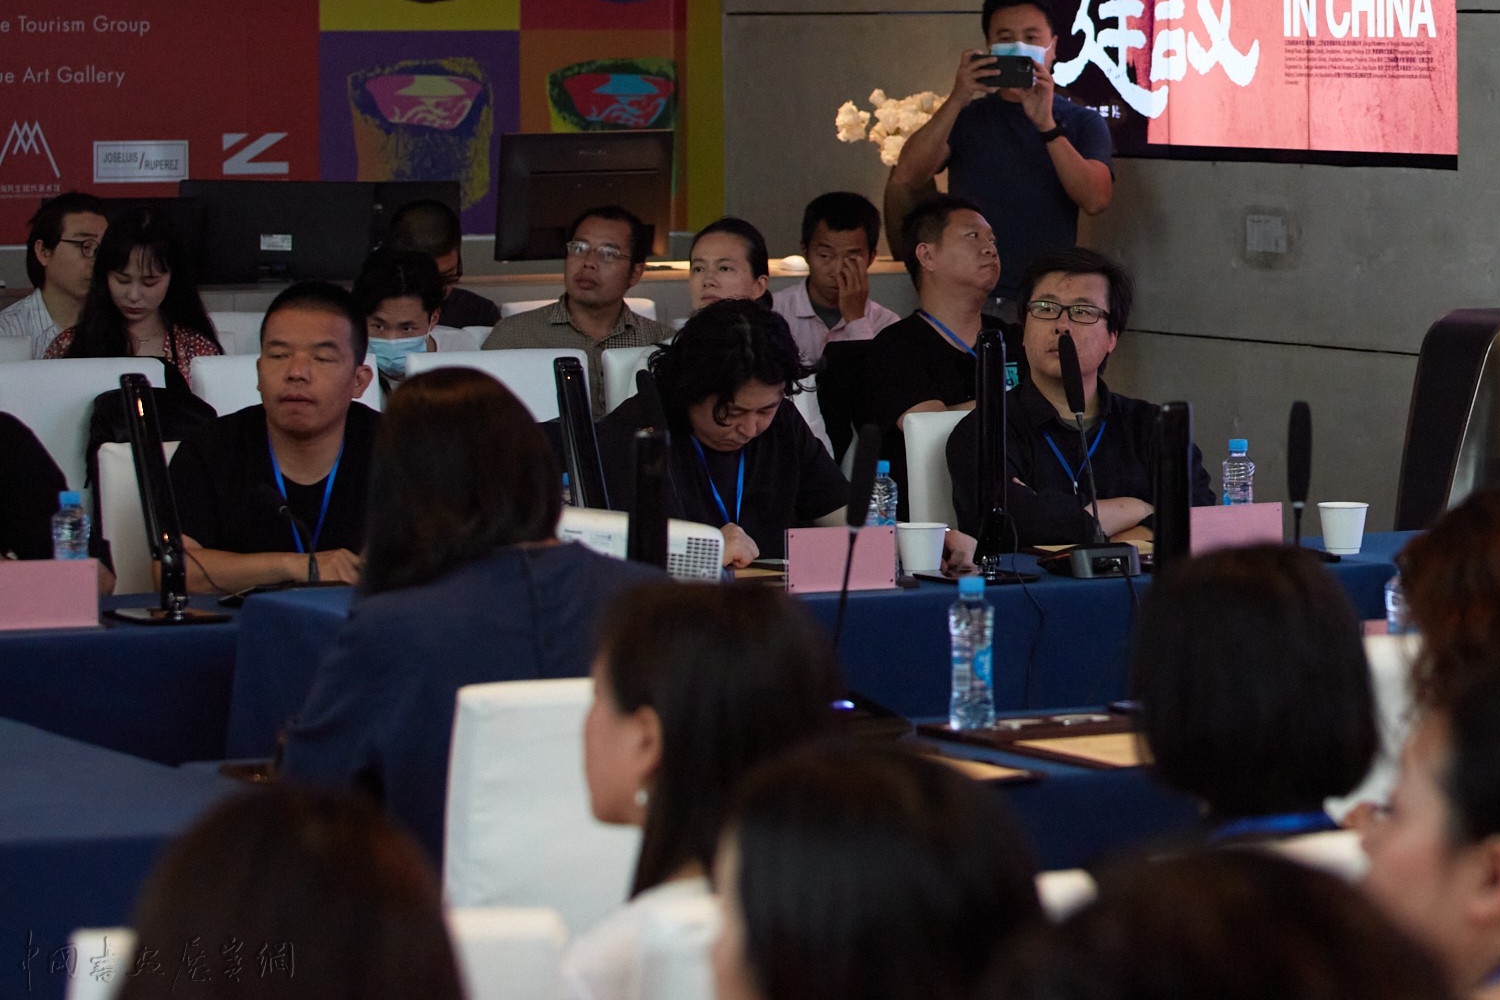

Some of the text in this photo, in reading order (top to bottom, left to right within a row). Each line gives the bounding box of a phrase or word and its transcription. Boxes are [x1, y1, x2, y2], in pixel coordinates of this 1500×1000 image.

[18, 14, 86, 34] Tourism
[93, 14, 152, 38] Group
[22, 66, 50, 84] Art
[57, 65, 126, 88] Gallery
[144, 159, 179, 170] RUPEREZ
